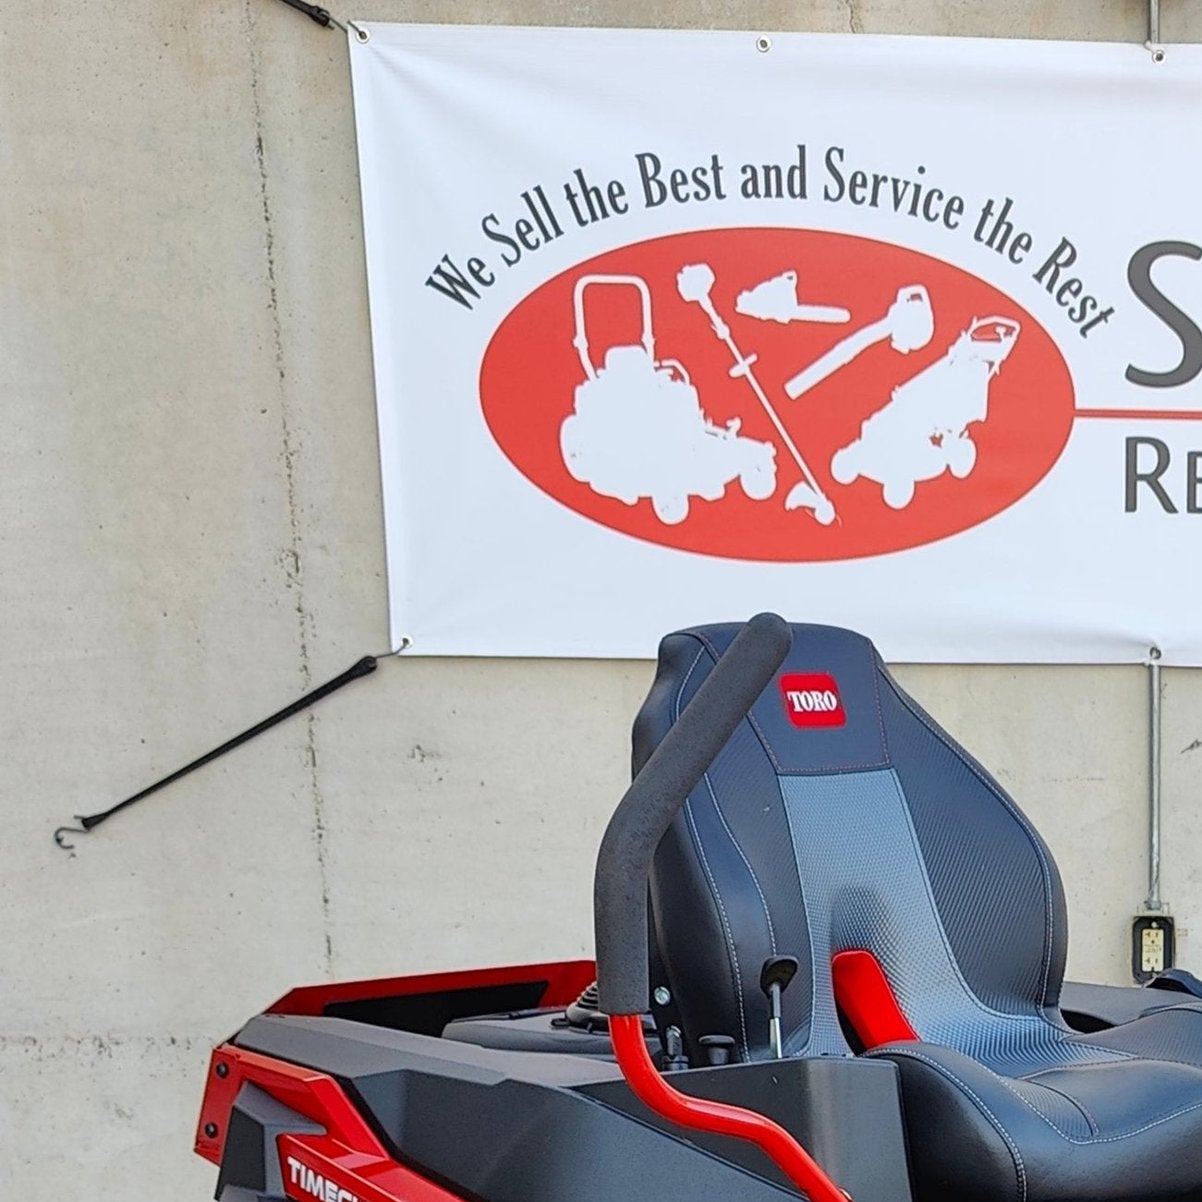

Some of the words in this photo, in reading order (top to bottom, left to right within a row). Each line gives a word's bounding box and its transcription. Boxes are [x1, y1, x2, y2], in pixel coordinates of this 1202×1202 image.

[425, 254, 495, 309] We
[482, 185, 564, 267] Sell
[564, 169, 628, 226] the
[635, 153, 726, 207] Best
[741, 145, 807, 199] and
[824, 147, 964, 229] Service
[974, 198, 1032, 264] the
[1033, 237, 1114, 338] Rest
[786, 690, 837, 712] TORO
